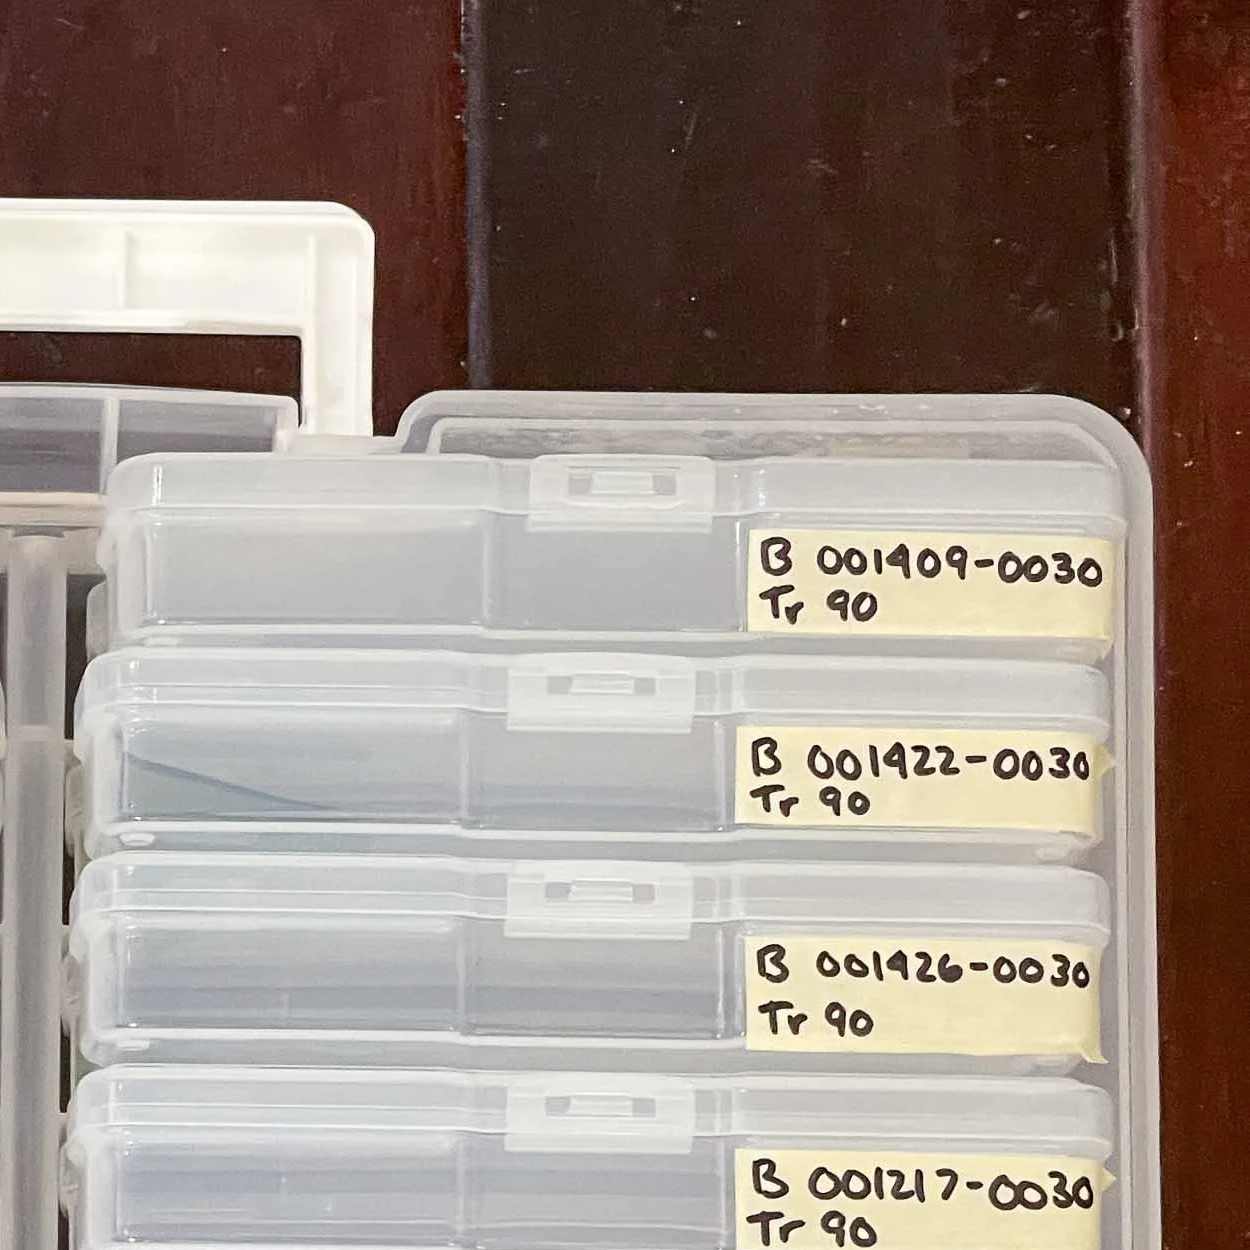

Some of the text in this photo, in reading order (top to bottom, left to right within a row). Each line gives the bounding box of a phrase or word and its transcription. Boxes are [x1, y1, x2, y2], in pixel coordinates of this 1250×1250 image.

[759, 535, 1104, 589] B 001409-0030
[757, 583, 879, 626] Tr 90
[750, 735, 1091, 782] B 001422-0030
[748, 783, 872, 819] Tr 90
[755, 942, 1091, 990] B 001426-0030
[756, 999, 875, 1039] Tr 90
[751, 1157, 1095, 1212] B 001217-0030
[744, 1209, 879, 1249] Tr 90
